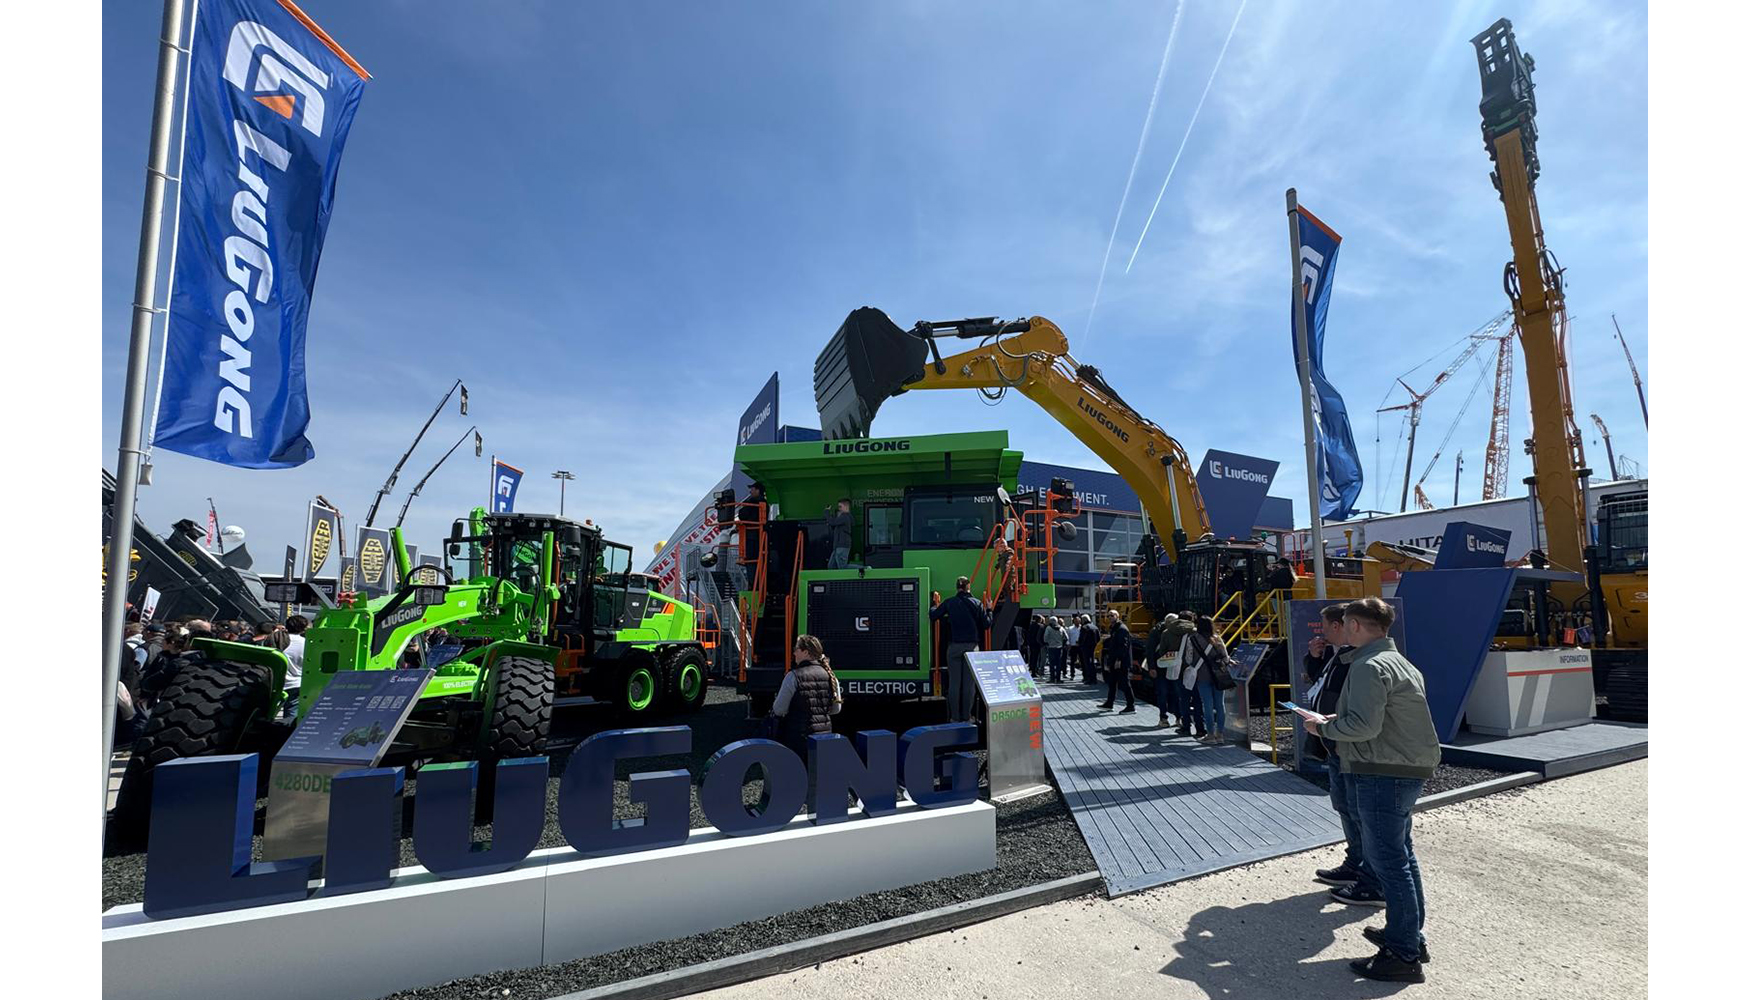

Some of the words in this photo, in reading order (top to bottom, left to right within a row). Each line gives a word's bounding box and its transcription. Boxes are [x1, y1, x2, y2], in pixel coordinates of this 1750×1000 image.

[1077, 396, 1130, 443] LIUGONG
[823, 440, 910, 454] LIUGONG
[1016, 484, 1034, 496] GH
[973, 496, 995, 504] NEW
[1399, 535, 1444, 549] HITA
[848, 682, 917, 694] ELECTRIC
[144, 722, 978, 919] LIUGONG
